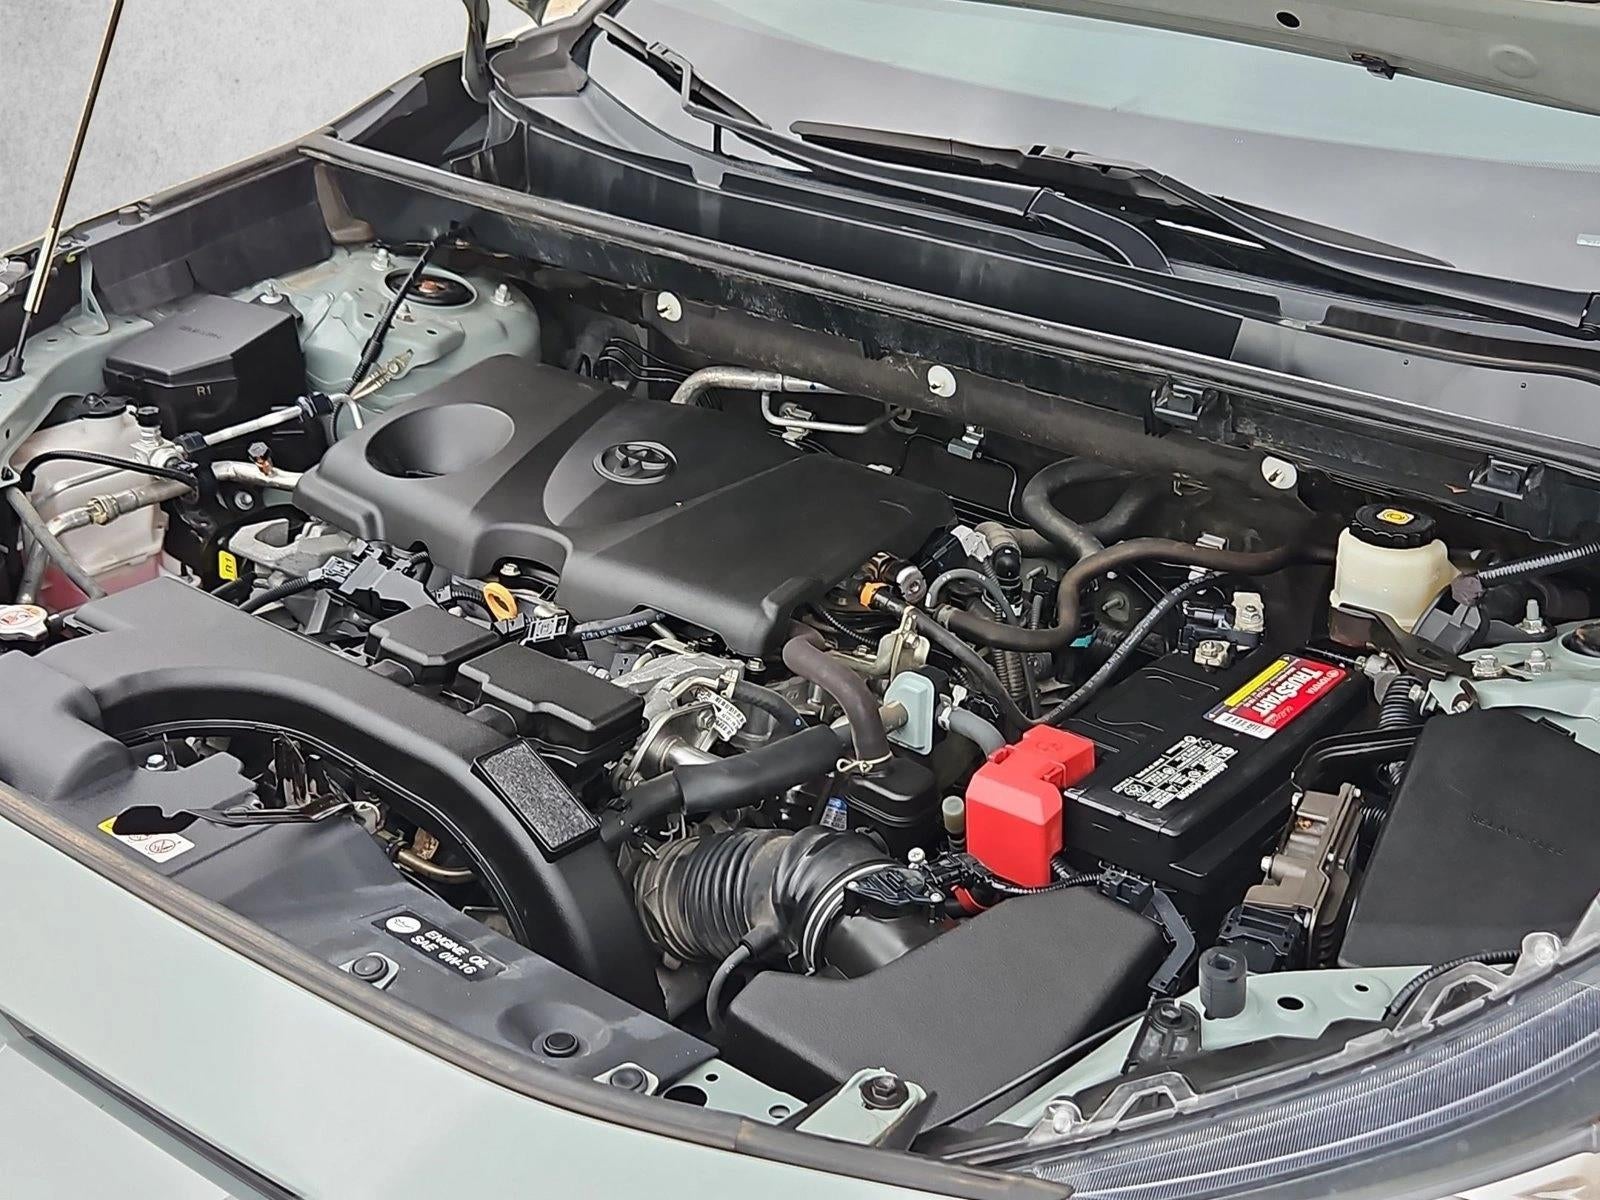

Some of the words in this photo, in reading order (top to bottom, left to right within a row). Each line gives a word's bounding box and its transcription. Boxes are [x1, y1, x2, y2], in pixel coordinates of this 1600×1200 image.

[197, 385, 211, 396] R1
[410, 935, 439, 952] SAE
[424, 930, 470, 955] ENGINE
[469, 955, 489, 970] OIL
